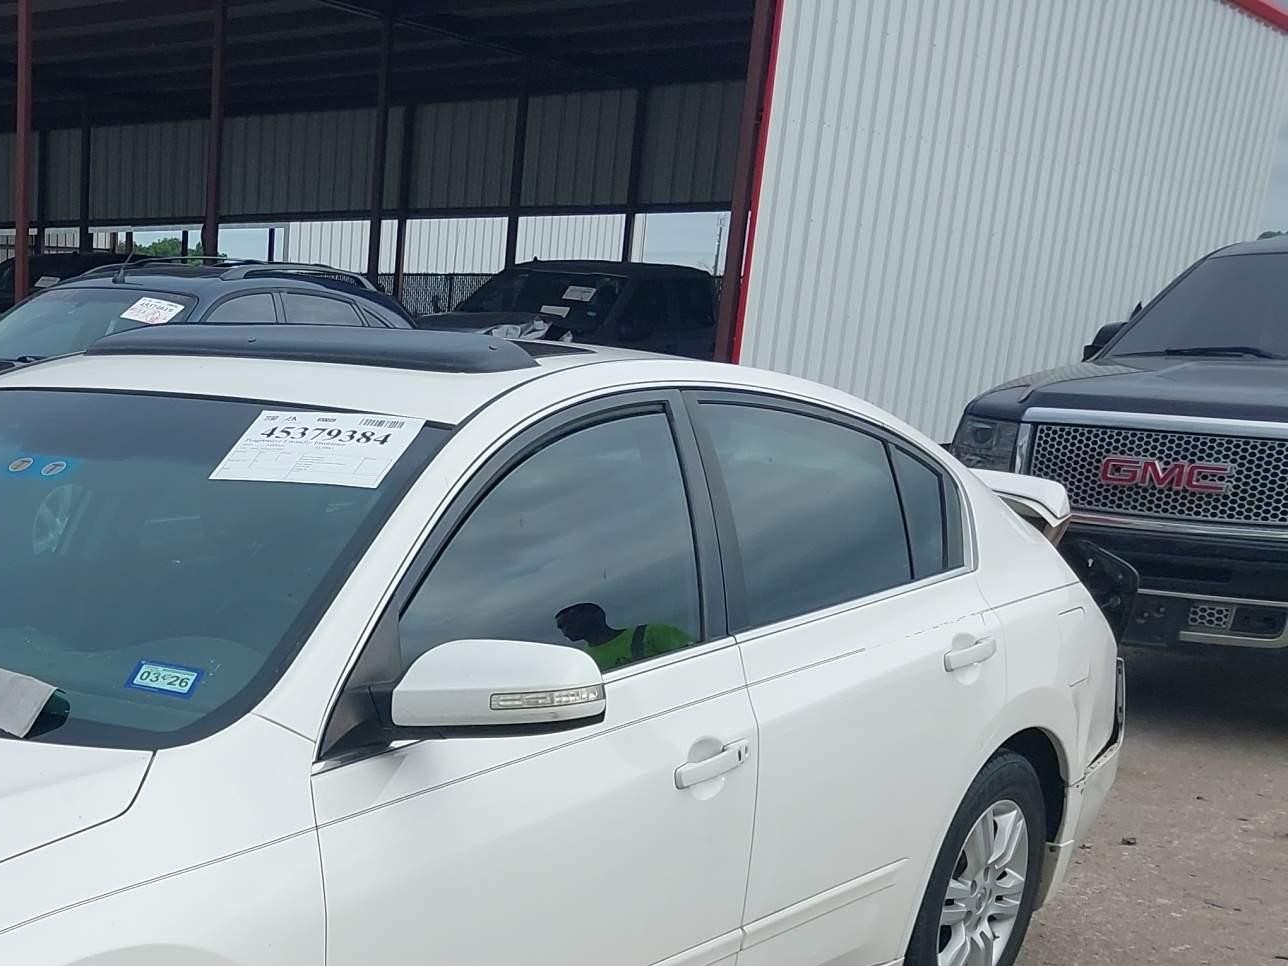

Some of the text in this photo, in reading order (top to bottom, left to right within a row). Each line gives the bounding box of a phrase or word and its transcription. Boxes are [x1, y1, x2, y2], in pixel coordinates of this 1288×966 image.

[260, 425, 392, 445] 45379384
[1101, 455, 1235, 493] GMC
[139, 670, 160, 683] 03
[166, 675, 190, 688] 26
